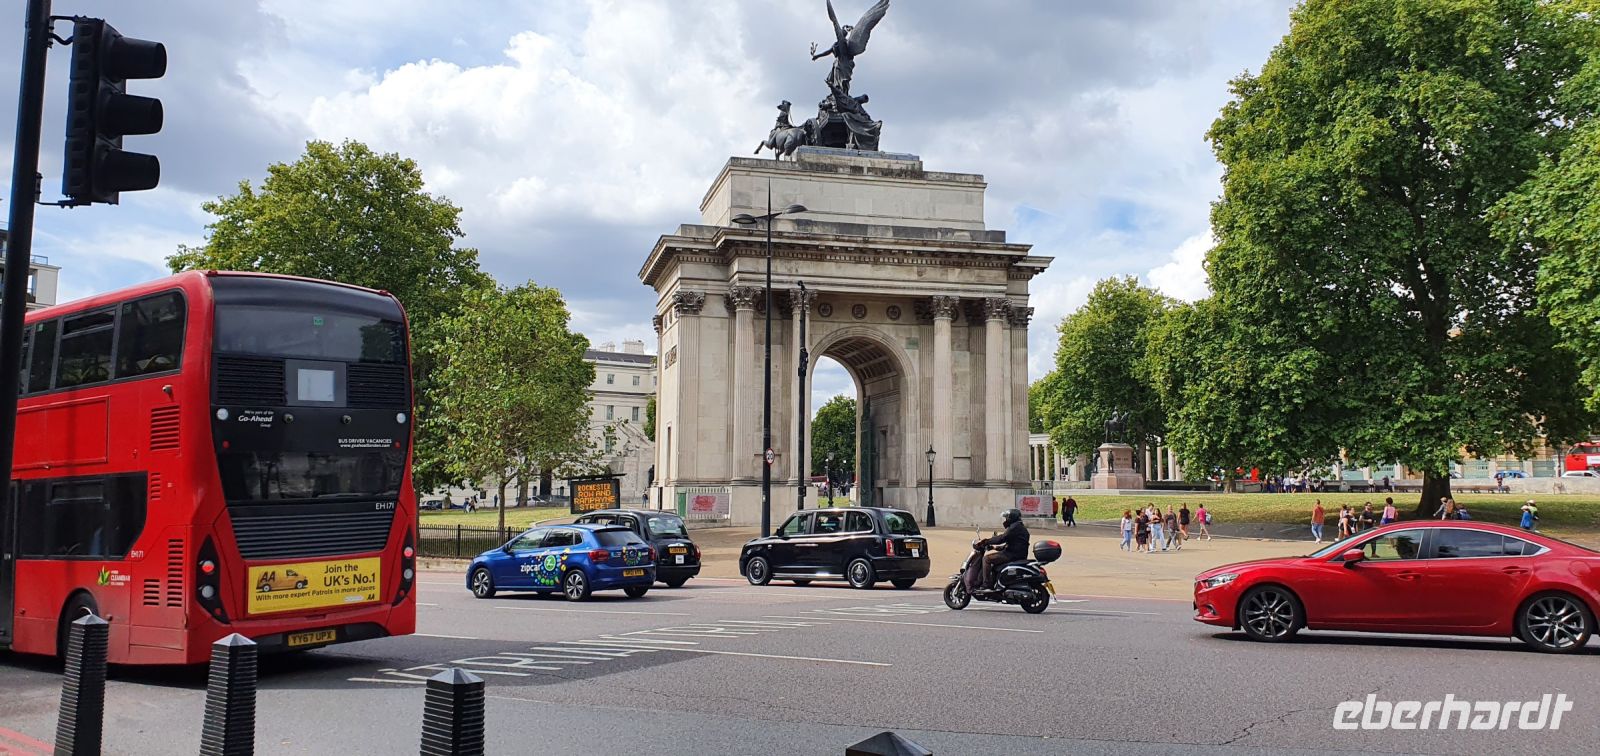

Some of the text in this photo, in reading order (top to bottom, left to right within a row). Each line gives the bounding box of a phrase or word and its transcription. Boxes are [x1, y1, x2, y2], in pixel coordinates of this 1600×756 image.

[577, 484, 611, 492] ROCHESTER
[578, 490, 593, 498] ROW
[574, 496, 616, 504] RAMPAYNE
[580, 502, 610, 510] STREET
[324, 564, 358, 574] Join the
[520, 561, 543, 574] zipcar
[260, 571, 276, 583] AA
[323, 573, 376, 587] UK's No.1
[290, 591, 311, 599] expert
[311, 589, 333, 597] Patrols
